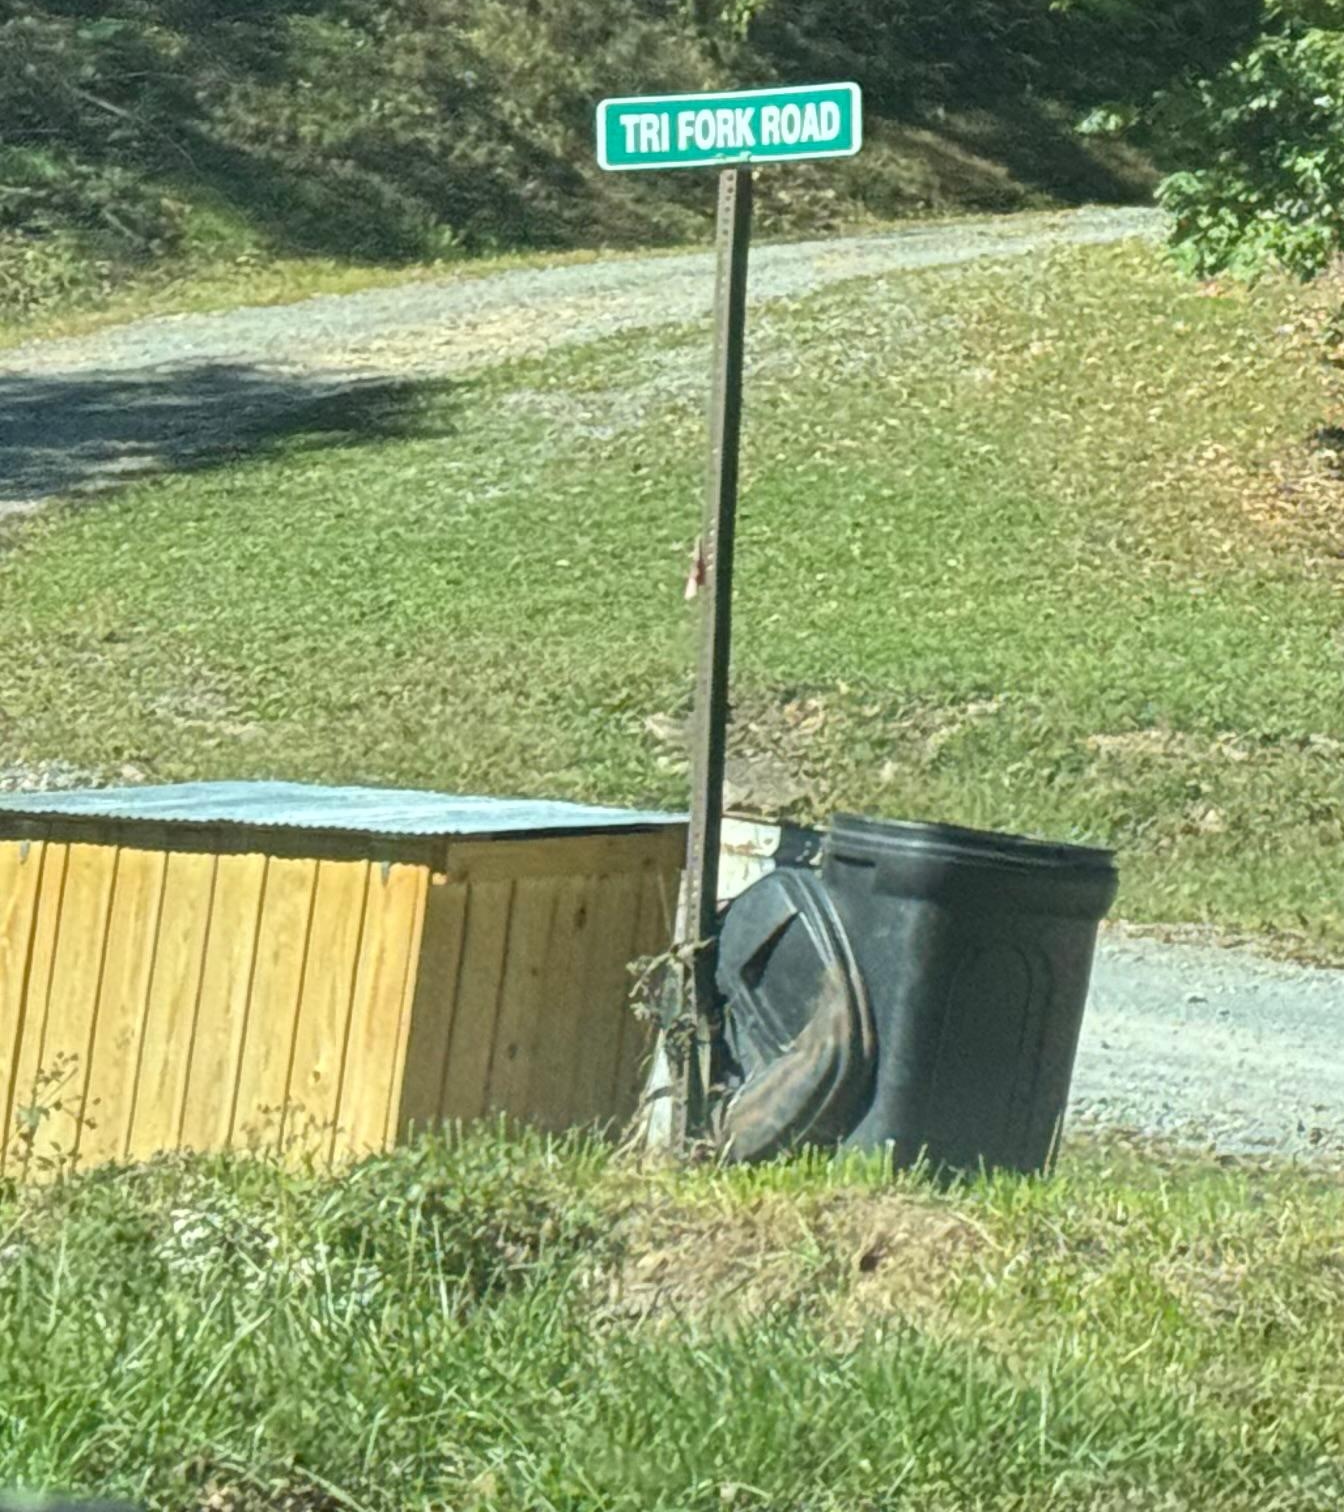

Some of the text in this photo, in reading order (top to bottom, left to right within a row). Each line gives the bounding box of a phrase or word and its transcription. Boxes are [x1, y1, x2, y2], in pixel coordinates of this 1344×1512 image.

[620, 101, 841, 153] TRI FORK ROAD
